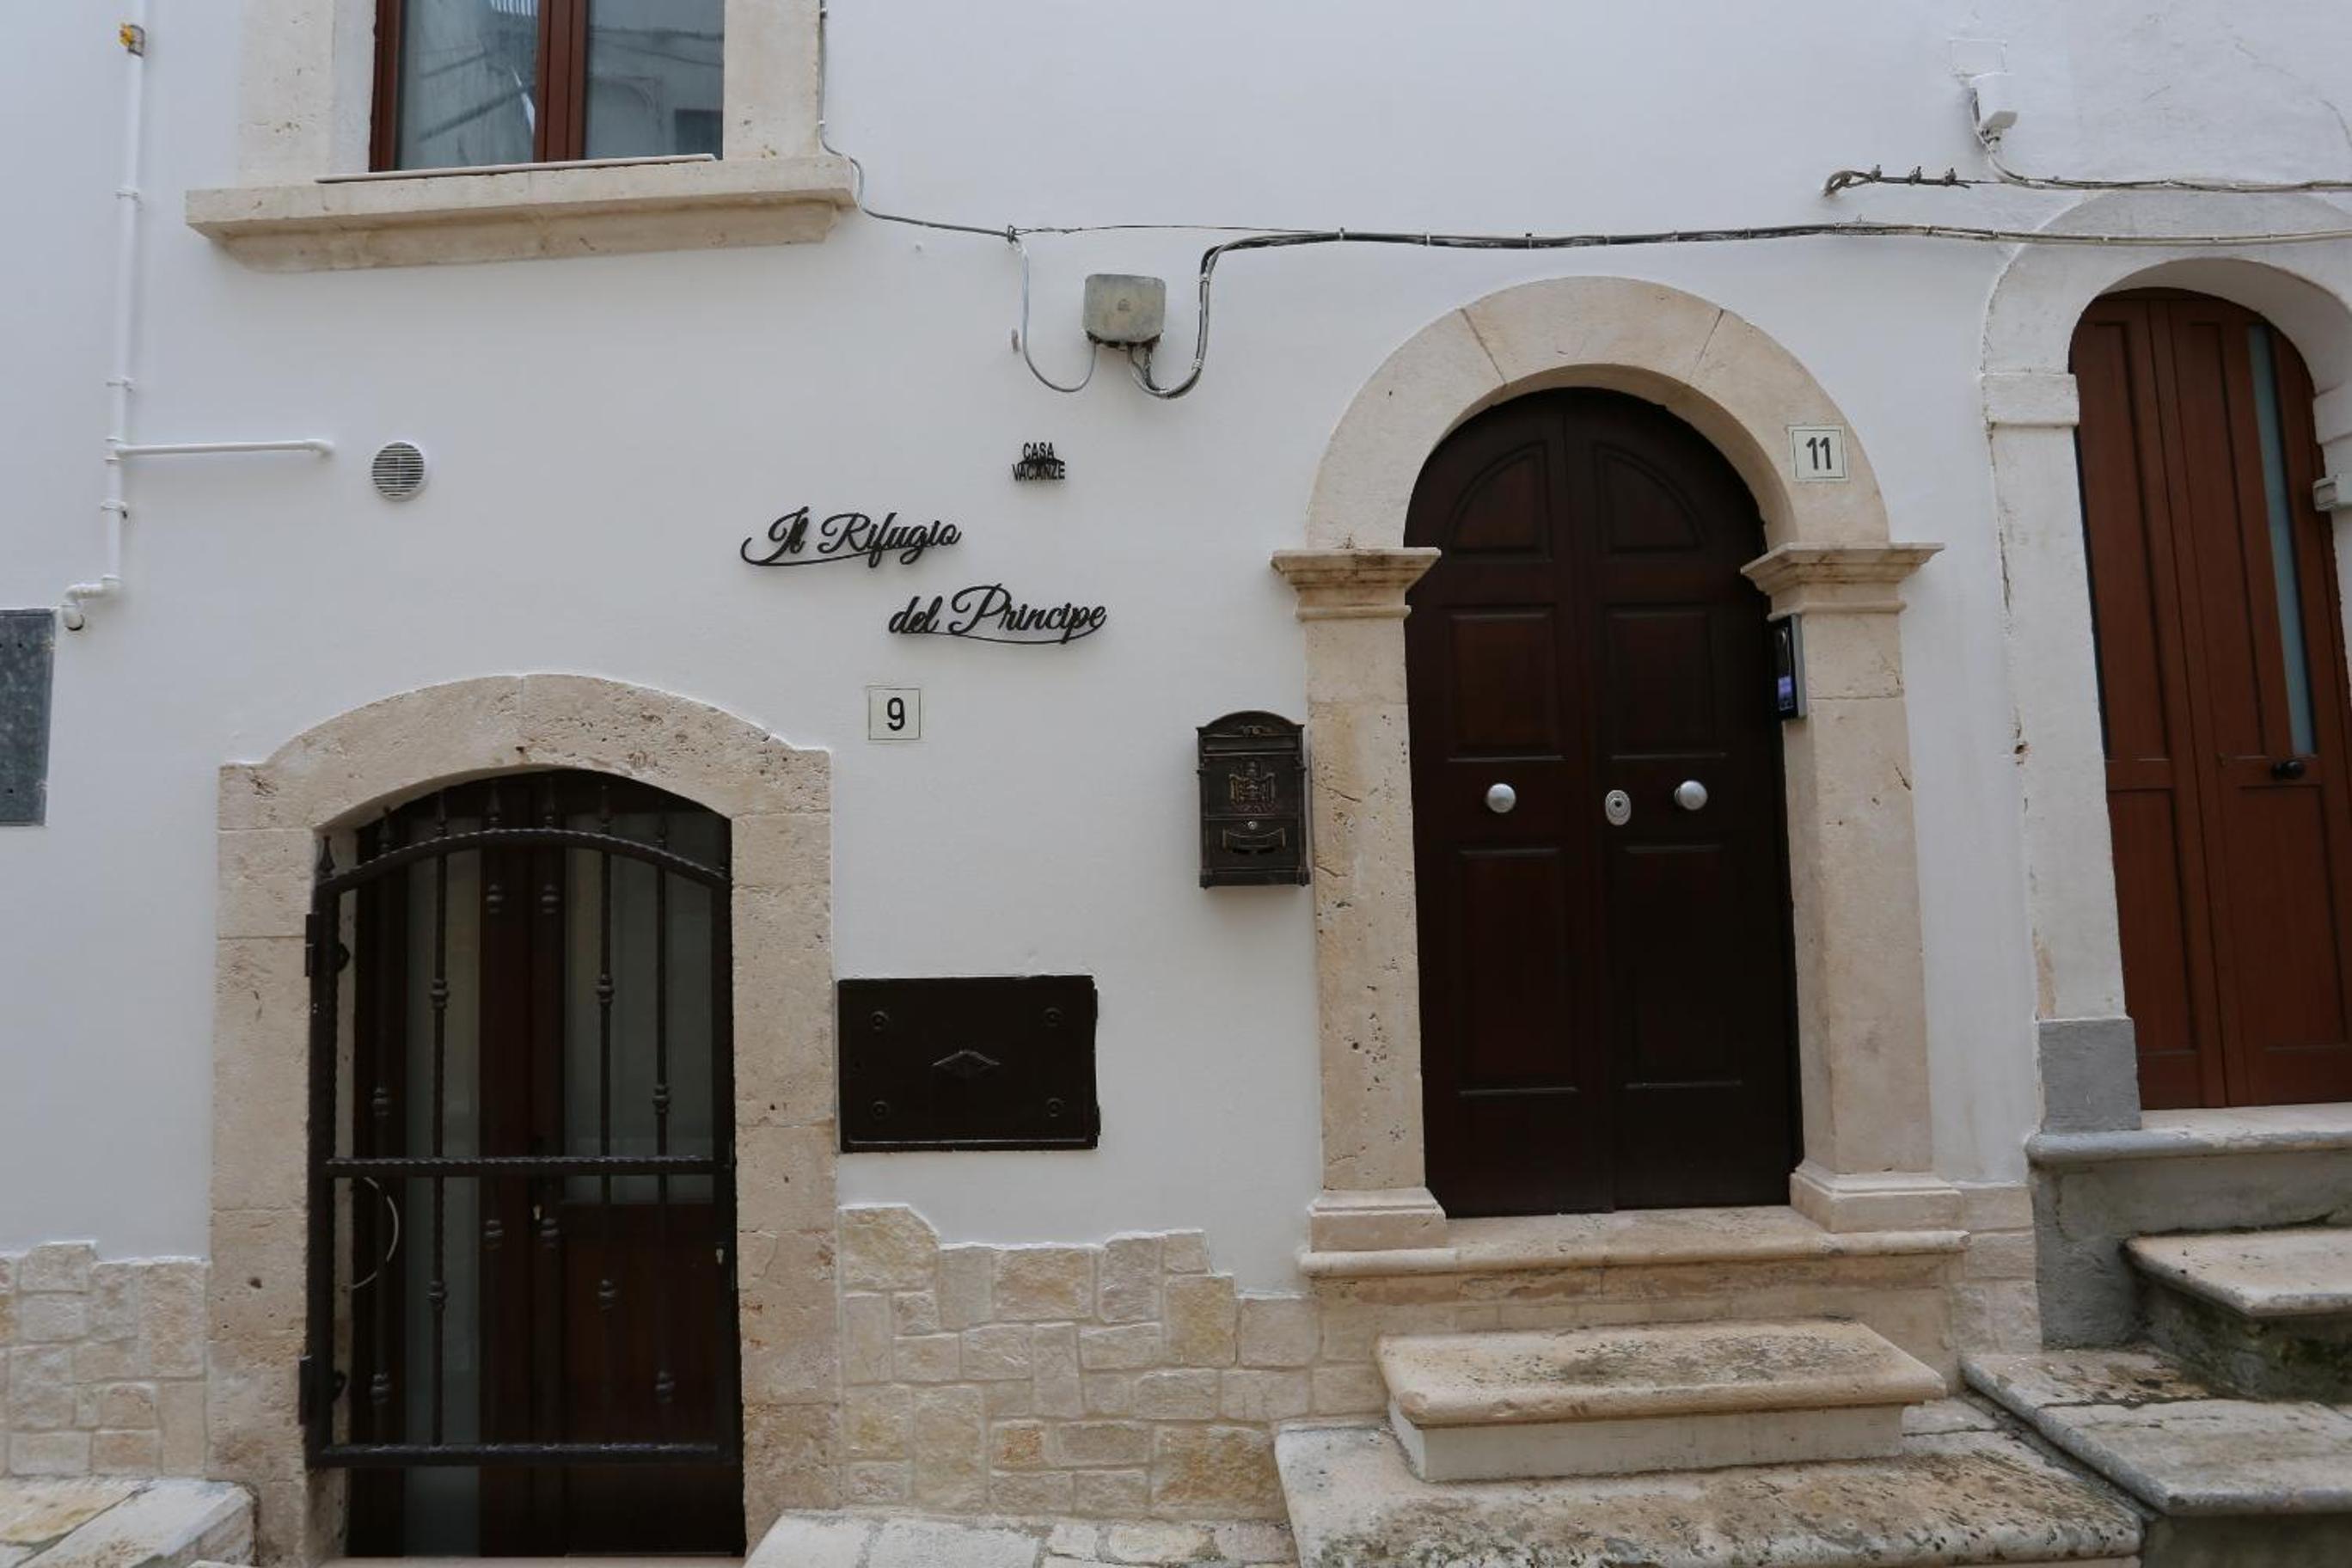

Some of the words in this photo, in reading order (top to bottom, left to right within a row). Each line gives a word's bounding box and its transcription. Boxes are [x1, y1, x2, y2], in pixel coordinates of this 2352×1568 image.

[1022, 442, 1055, 462] CASA
[1806, 437, 1832, 470] 11
[1011, 462, 1066, 481] VACANZE
[741, 505, 810, 566] Il
[817, 511, 962, 568] Rifugio
[888, 595, 944, 634] del
[947, 583, 1108, 645] Principe
[885, 696, 906, 732] 9
